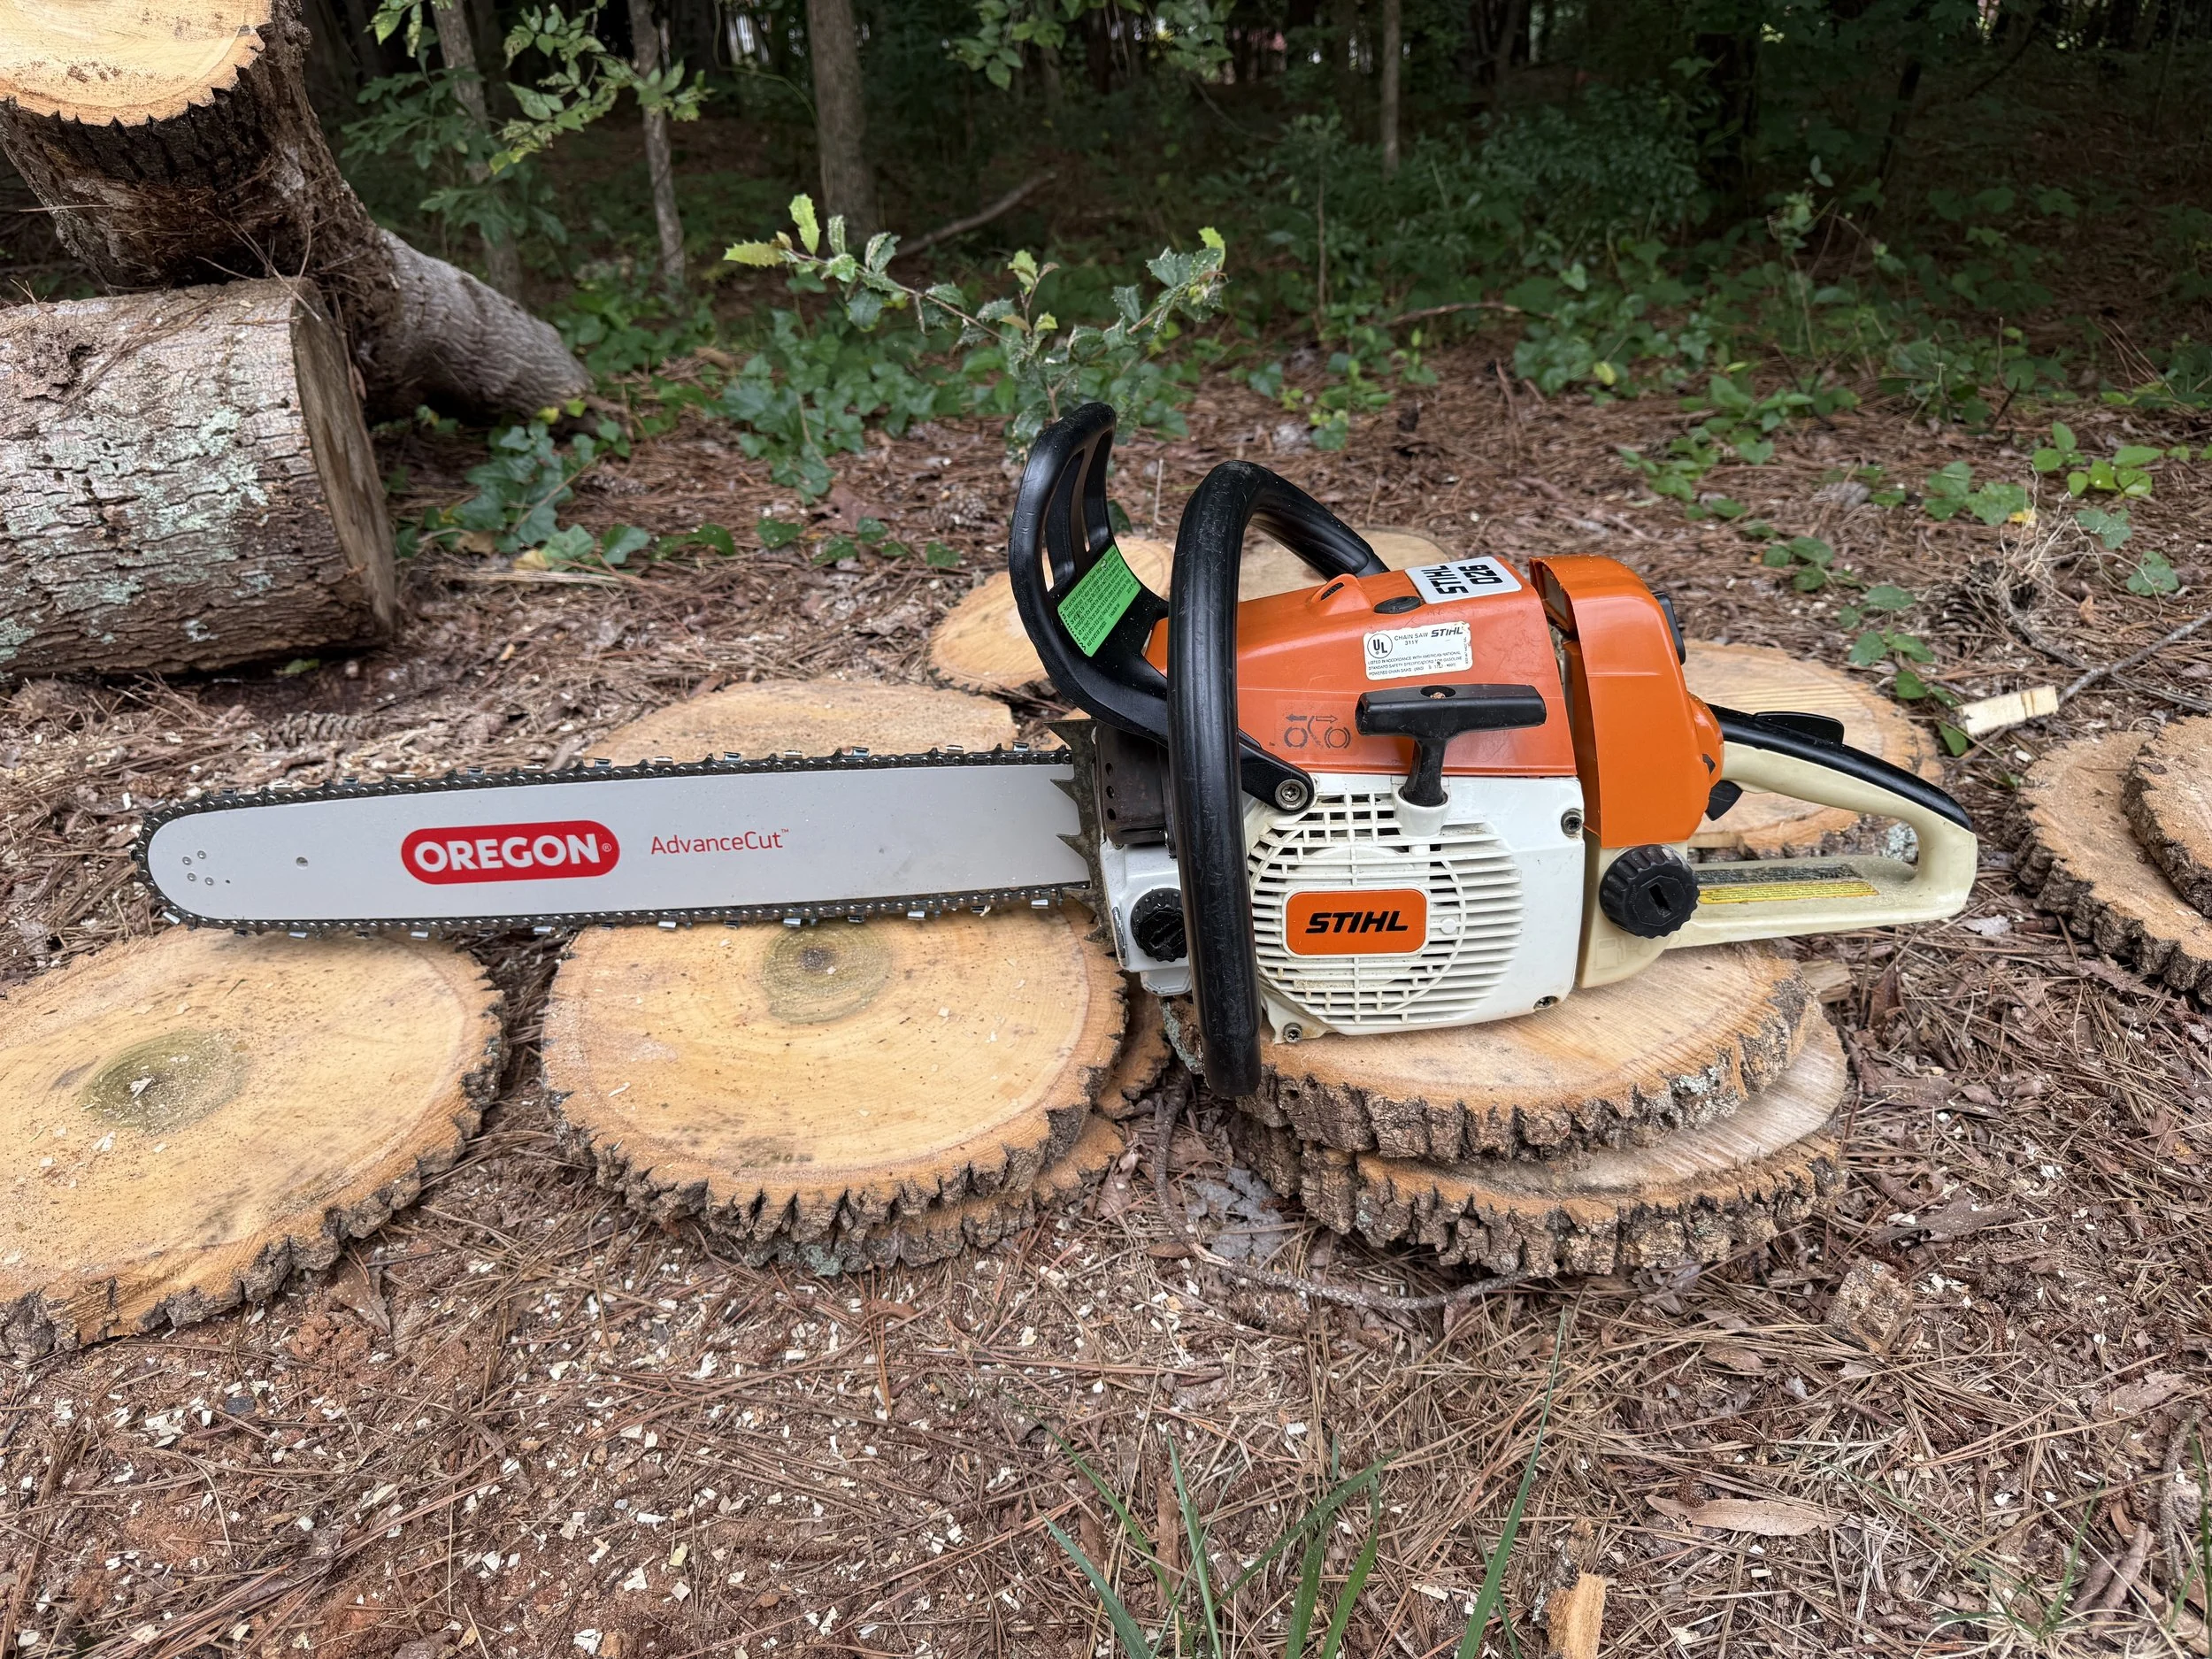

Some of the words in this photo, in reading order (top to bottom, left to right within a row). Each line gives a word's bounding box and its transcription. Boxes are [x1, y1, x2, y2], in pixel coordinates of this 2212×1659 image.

[1421, 565, 1469, 595] STIHL
[1457, 565, 1503, 585] 026
[1431, 626, 1463, 638] STIHL
[1373, 639, 1388, 653] UL
[1305, 910, 1409, 933] STIHL
